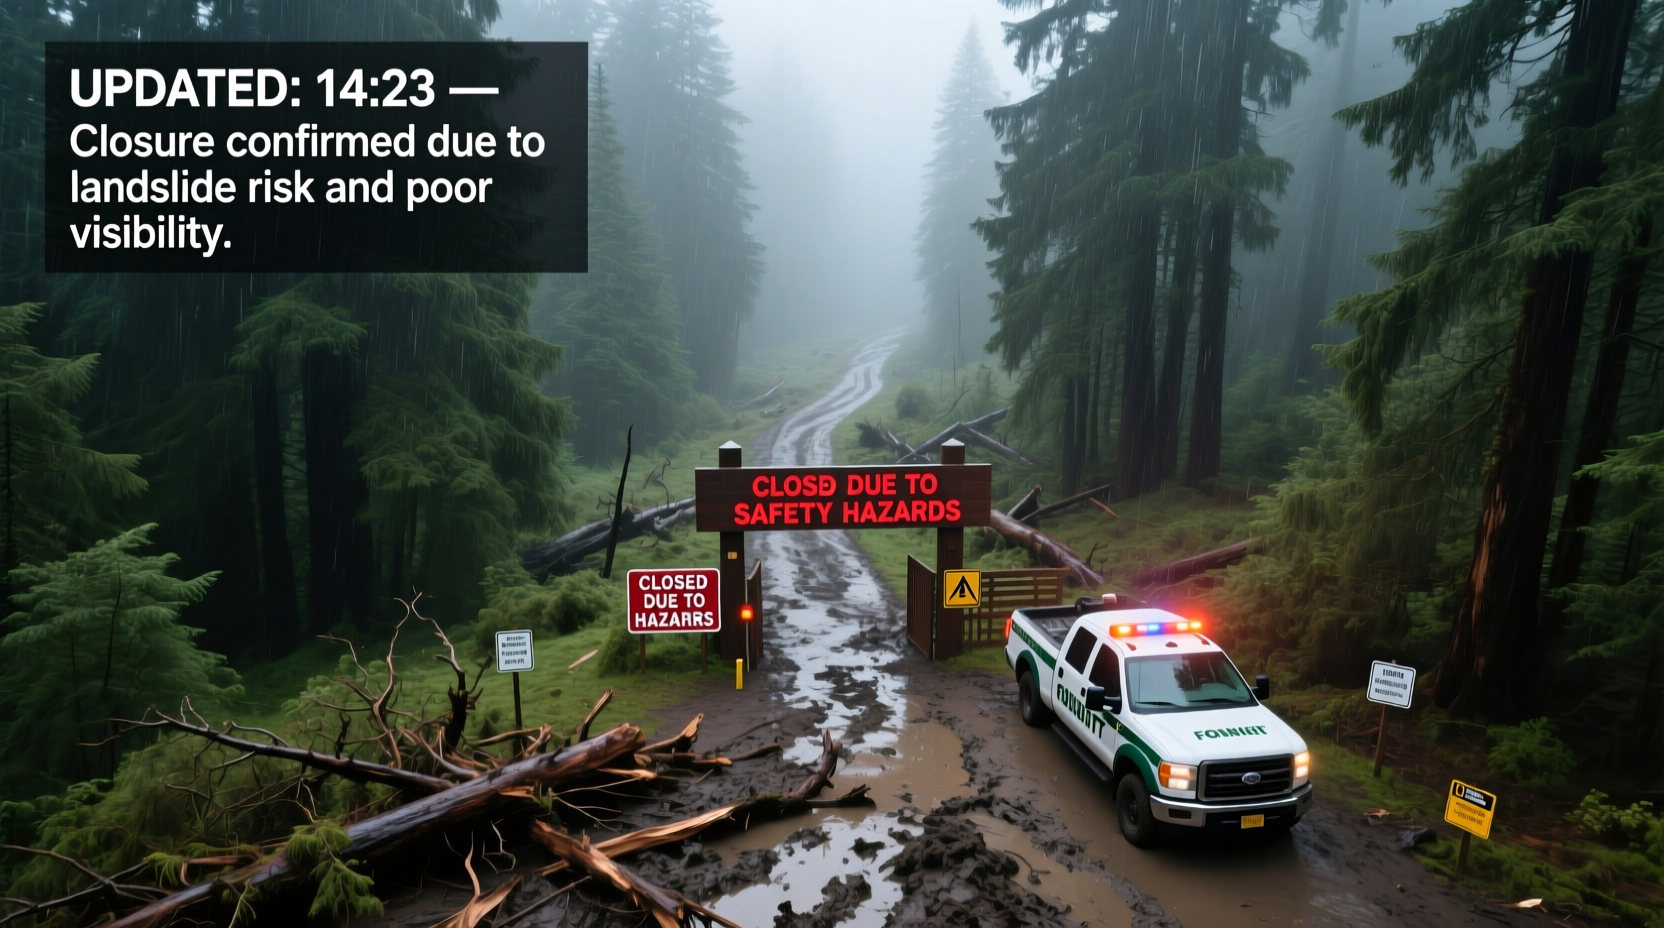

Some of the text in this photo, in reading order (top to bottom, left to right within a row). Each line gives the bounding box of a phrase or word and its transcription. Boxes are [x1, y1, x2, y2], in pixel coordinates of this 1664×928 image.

[847, 473, 897, 496] DUE
[904, 472, 938, 495] TO
[734, 499, 961, 526] SAFETY HAZARDS
[638, 574, 708, 591] CLOSED
[643, 592, 706, 609] DUE TO
